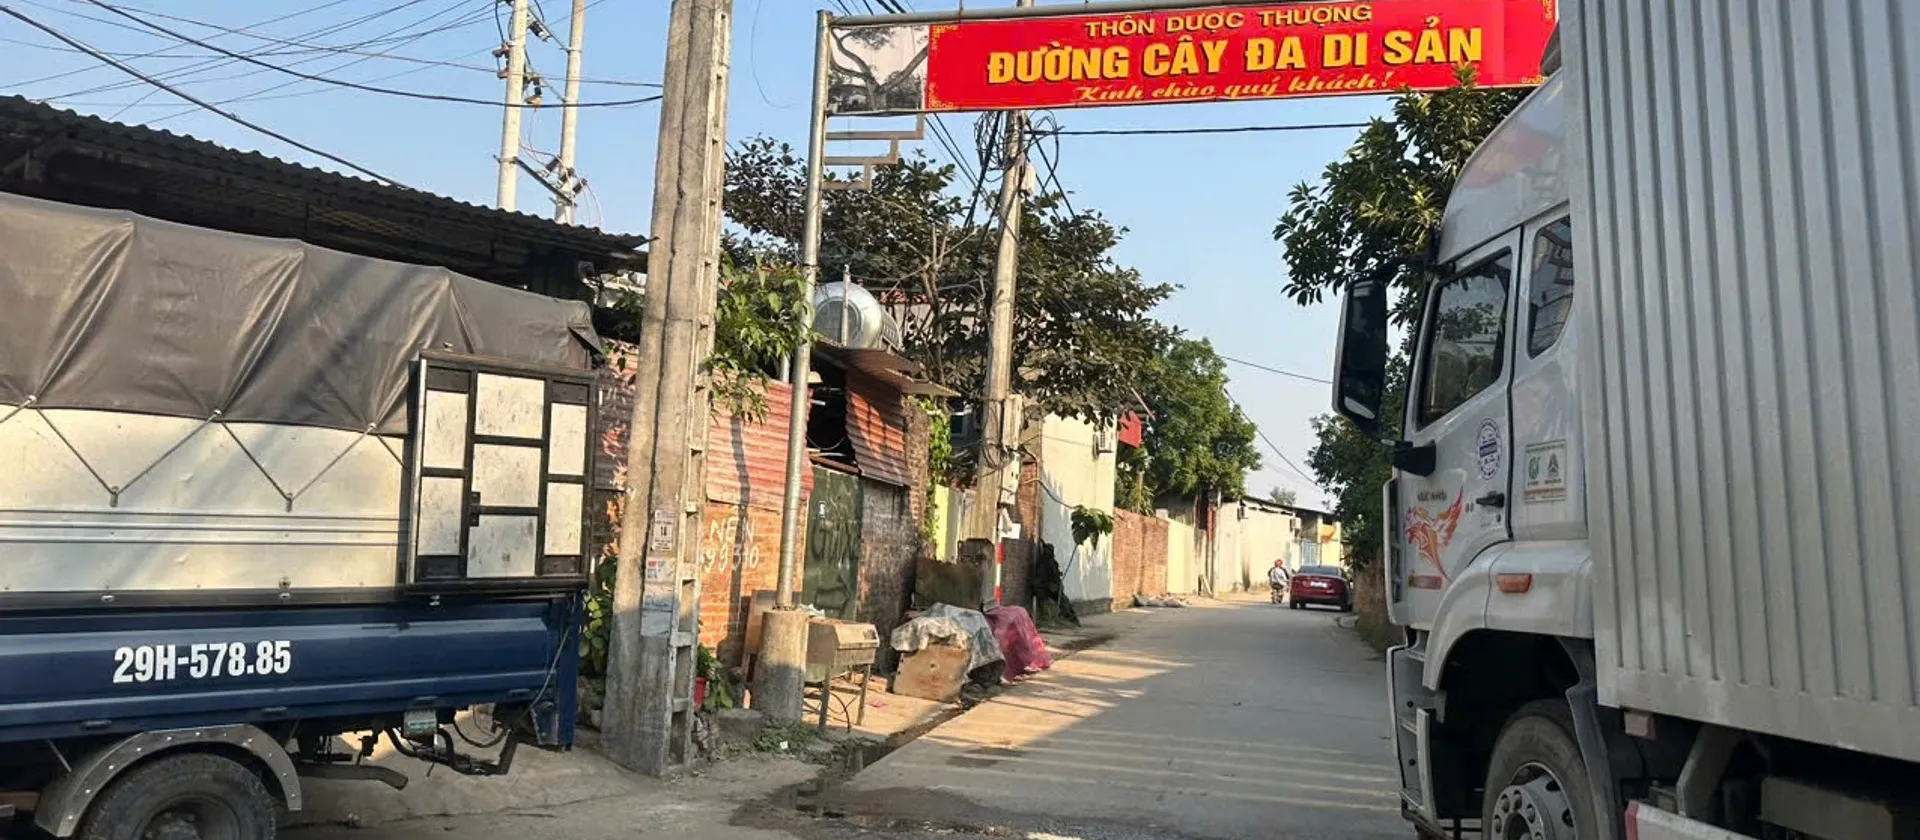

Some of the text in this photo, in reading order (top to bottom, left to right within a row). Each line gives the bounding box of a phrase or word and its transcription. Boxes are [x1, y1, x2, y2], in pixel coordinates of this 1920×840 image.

[1086, 15, 1155, 37] THÔN
[1259, 5, 1372, 28] THƯỢNG
[987, 16, 1482, 84] ĐƯỜNG CÂY ĐA DI SẢN
[1075, 72, 1394, 101] Kính chào quý khách!
[113, 640, 291, 683] 29H-578.85
